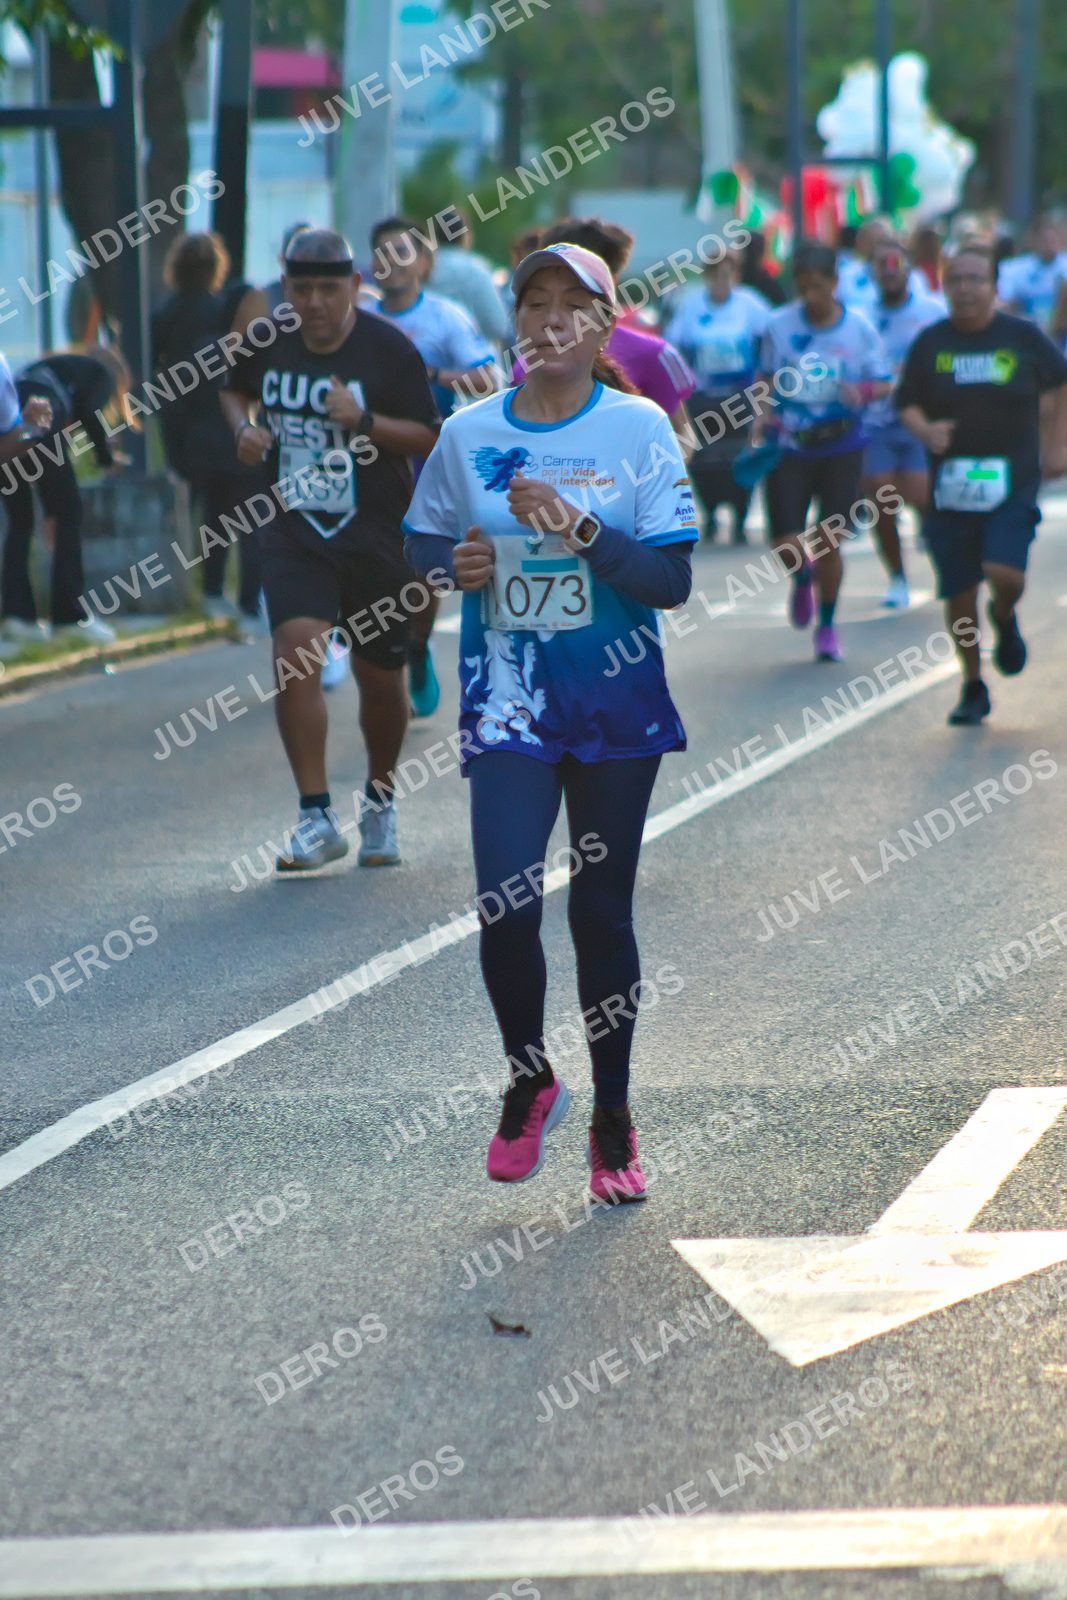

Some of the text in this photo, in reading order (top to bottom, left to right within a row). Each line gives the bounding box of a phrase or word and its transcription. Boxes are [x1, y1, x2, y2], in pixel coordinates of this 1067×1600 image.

[542, 455, 596, 467] Carrera
[541, 467, 596, 478] por la Vida
